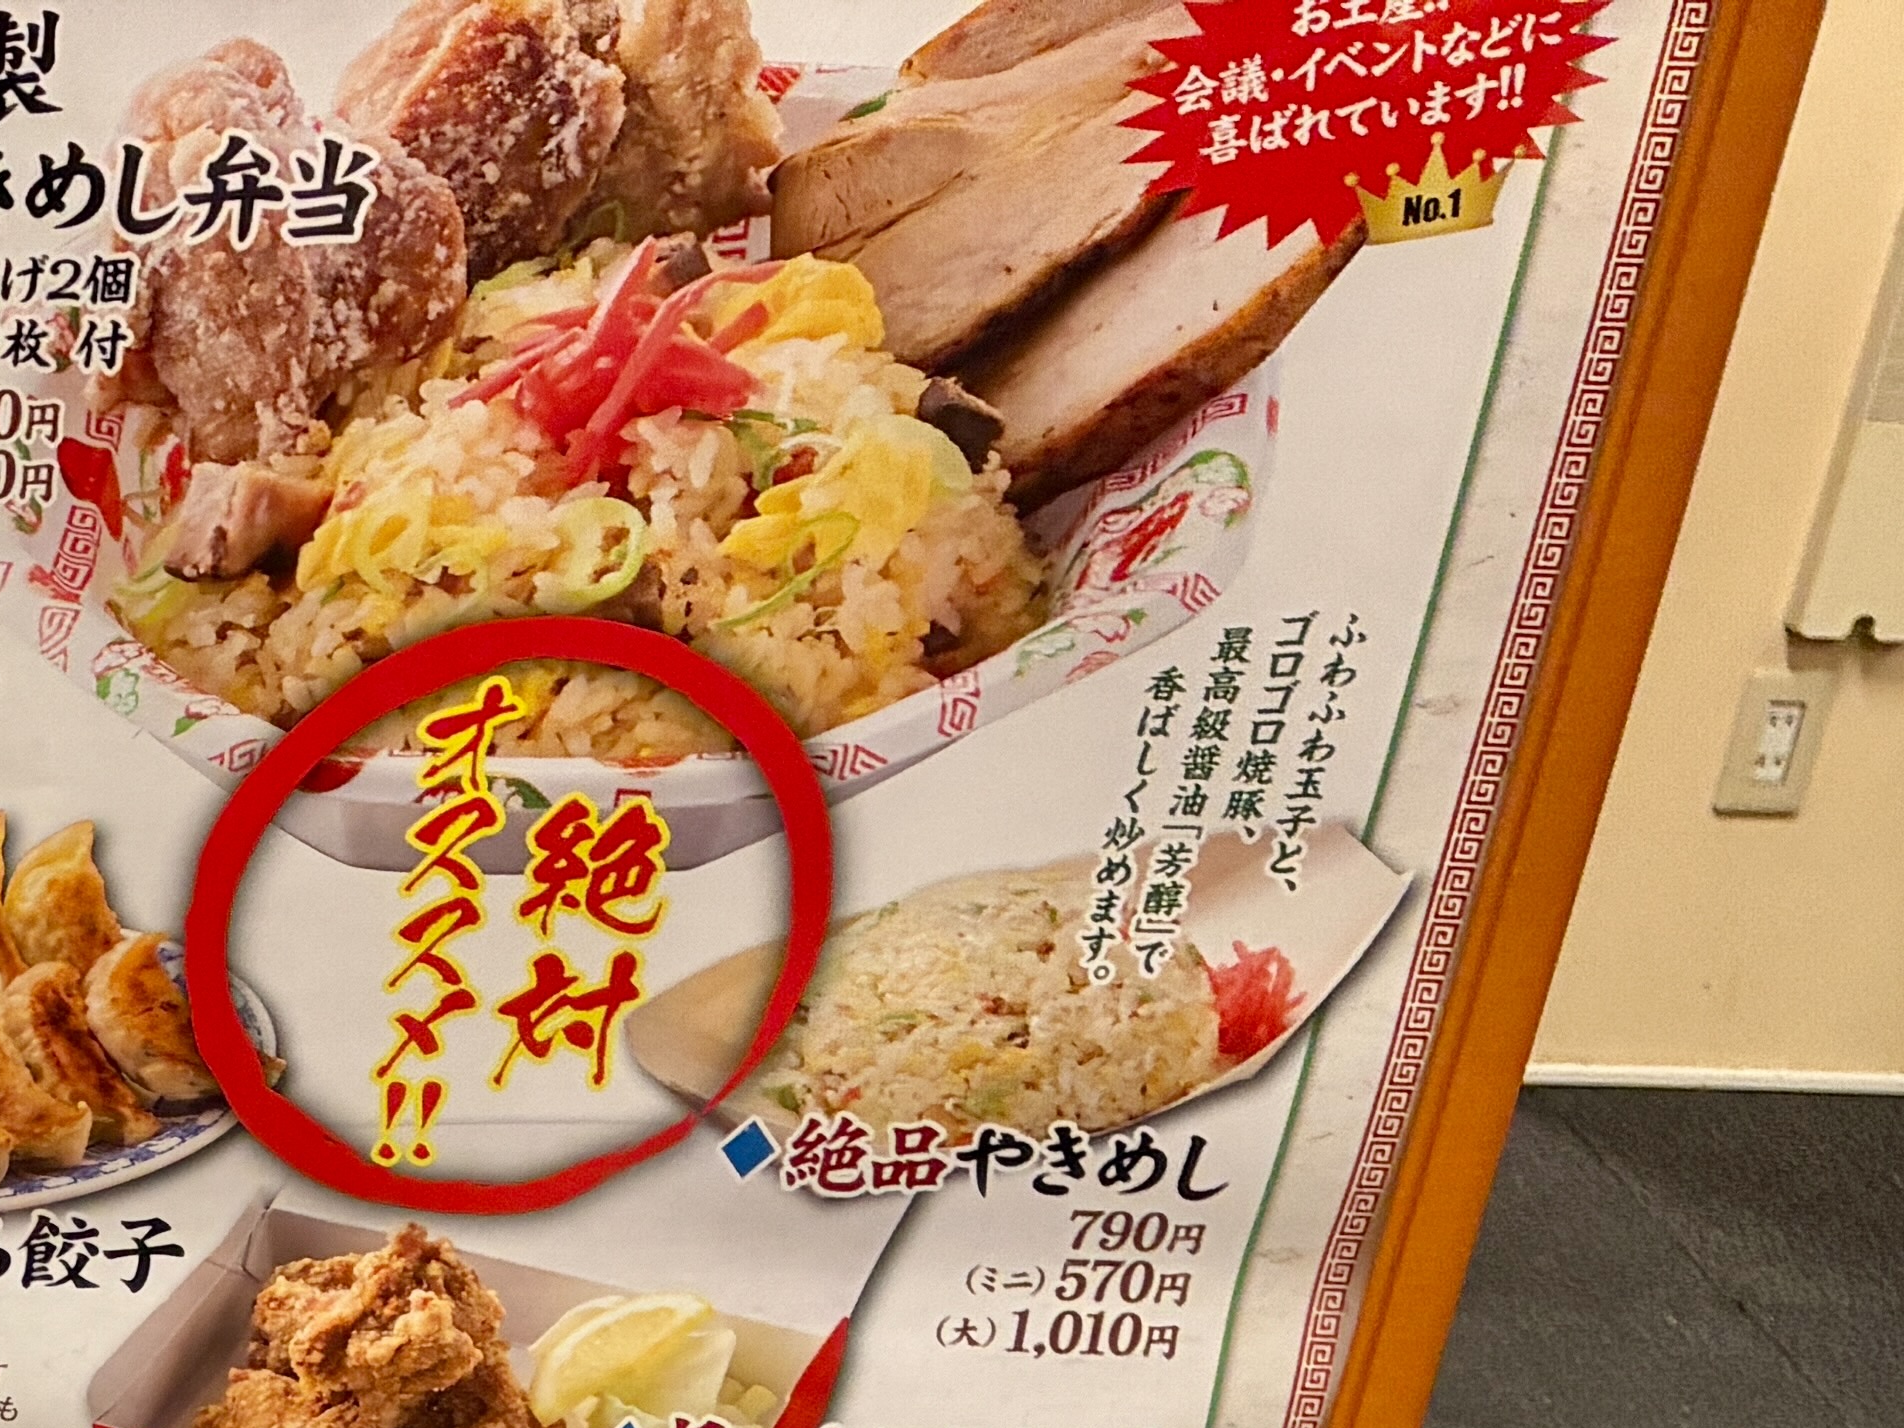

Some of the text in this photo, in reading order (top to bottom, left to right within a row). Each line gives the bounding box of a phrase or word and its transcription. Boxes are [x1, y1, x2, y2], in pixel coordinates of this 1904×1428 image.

[1173, 12, 1562, 114] 会議・イベントなどに
[1293, 0, 1449, 36] お土産
[1199, 64, 1525, 164] 喜ばれています!!
[1402, 188, 1461, 226] No.1
[76, 319, 129, 369] 付
[1222, 610, 1320, 839] ゴロゴロ焼豚、
[1270, 613, 1368, 891] ふわふわ玉子と、
[1082, 665, 1187, 981] 香ばしく炒めます。
[375, 684, 518, 1161] オススメ!!
[495, 799, 665, 1086] 絶対
[785, 1117, 1230, 1200] 絶品やきめし
[1068, 1210, 1206, 1255] 790円
[1056, 1260, 1191, 1307] 570円
[1005, 1310, 1180, 1360] 1,010円
